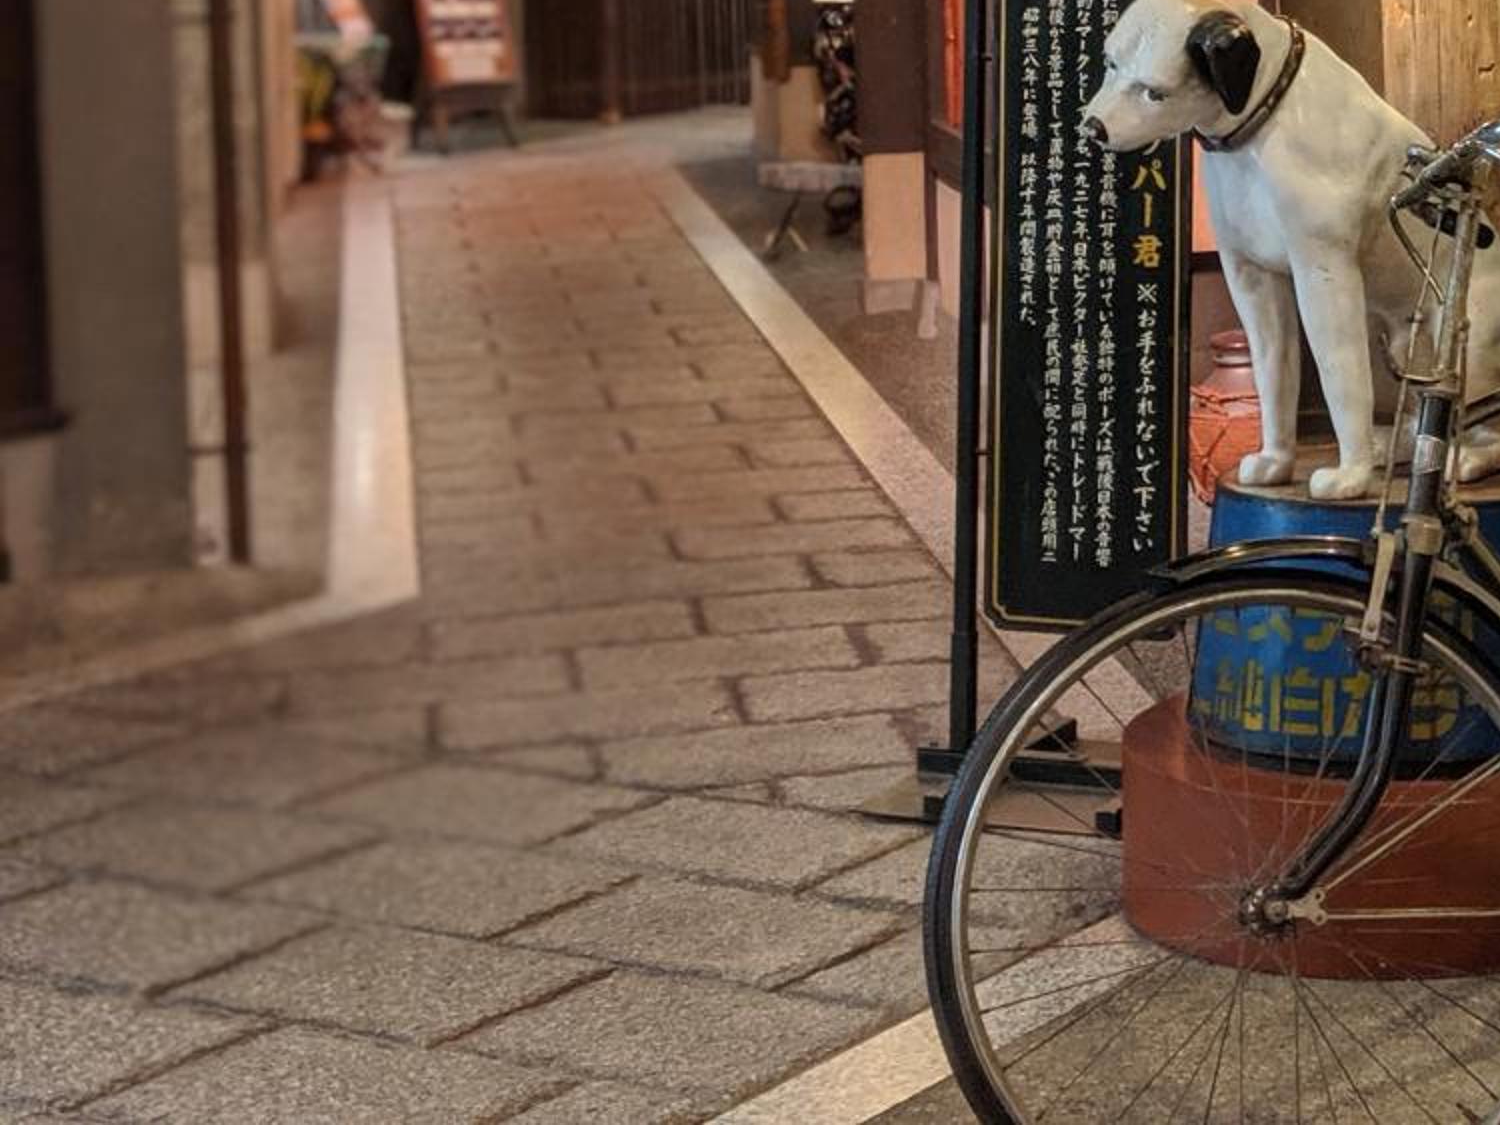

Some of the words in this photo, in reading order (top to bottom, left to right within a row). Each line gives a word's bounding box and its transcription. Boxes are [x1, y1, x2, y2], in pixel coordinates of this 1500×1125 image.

[1132, 282, 1161, 553] ※お手をふれないで下さい
